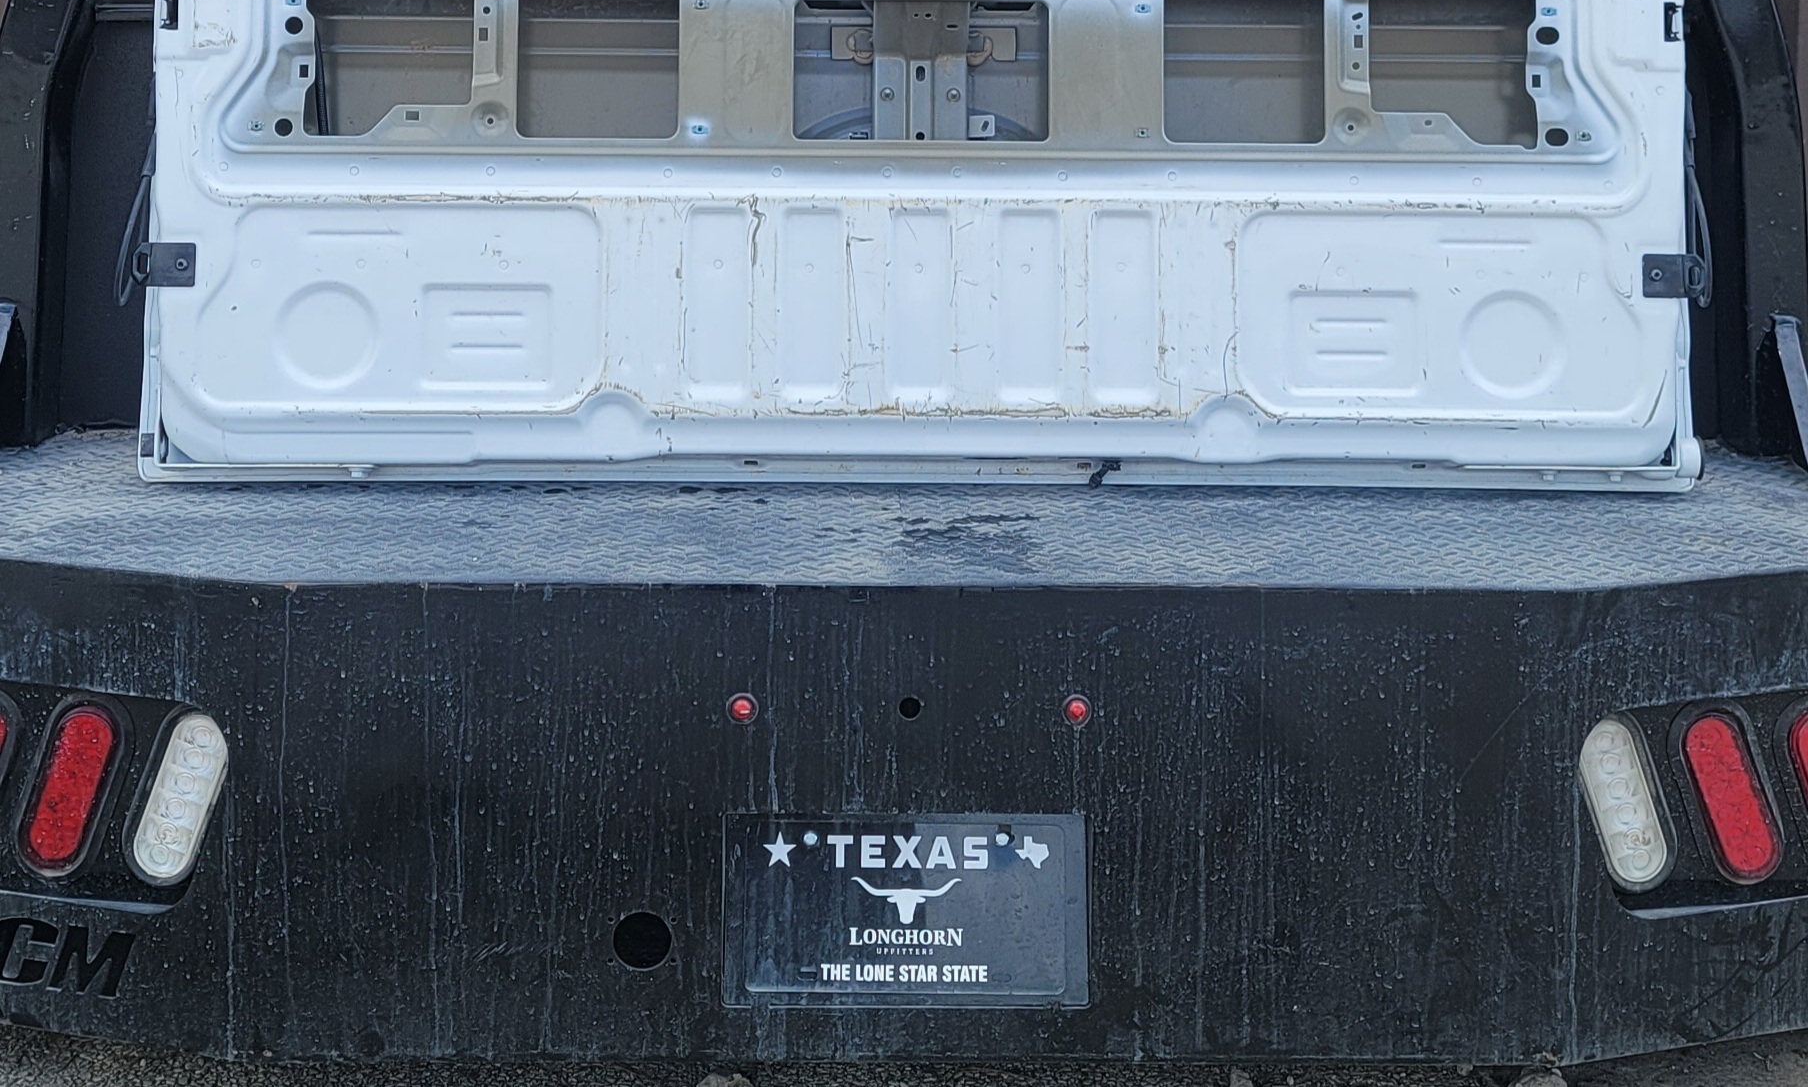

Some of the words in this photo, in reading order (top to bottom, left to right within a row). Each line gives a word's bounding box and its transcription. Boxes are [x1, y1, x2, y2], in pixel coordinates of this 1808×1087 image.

[826, 834, 990, 870] TEXAS
[848, 926, 964, 947] LONGHORN
[876, 947, 935, 956] UPFITTERS
[820, 963, 851, 982] THE
[855, 963, 895, 982] LONE
[898, 963, 939, 983] STAR
[942, 963, 989, 983] STATE
